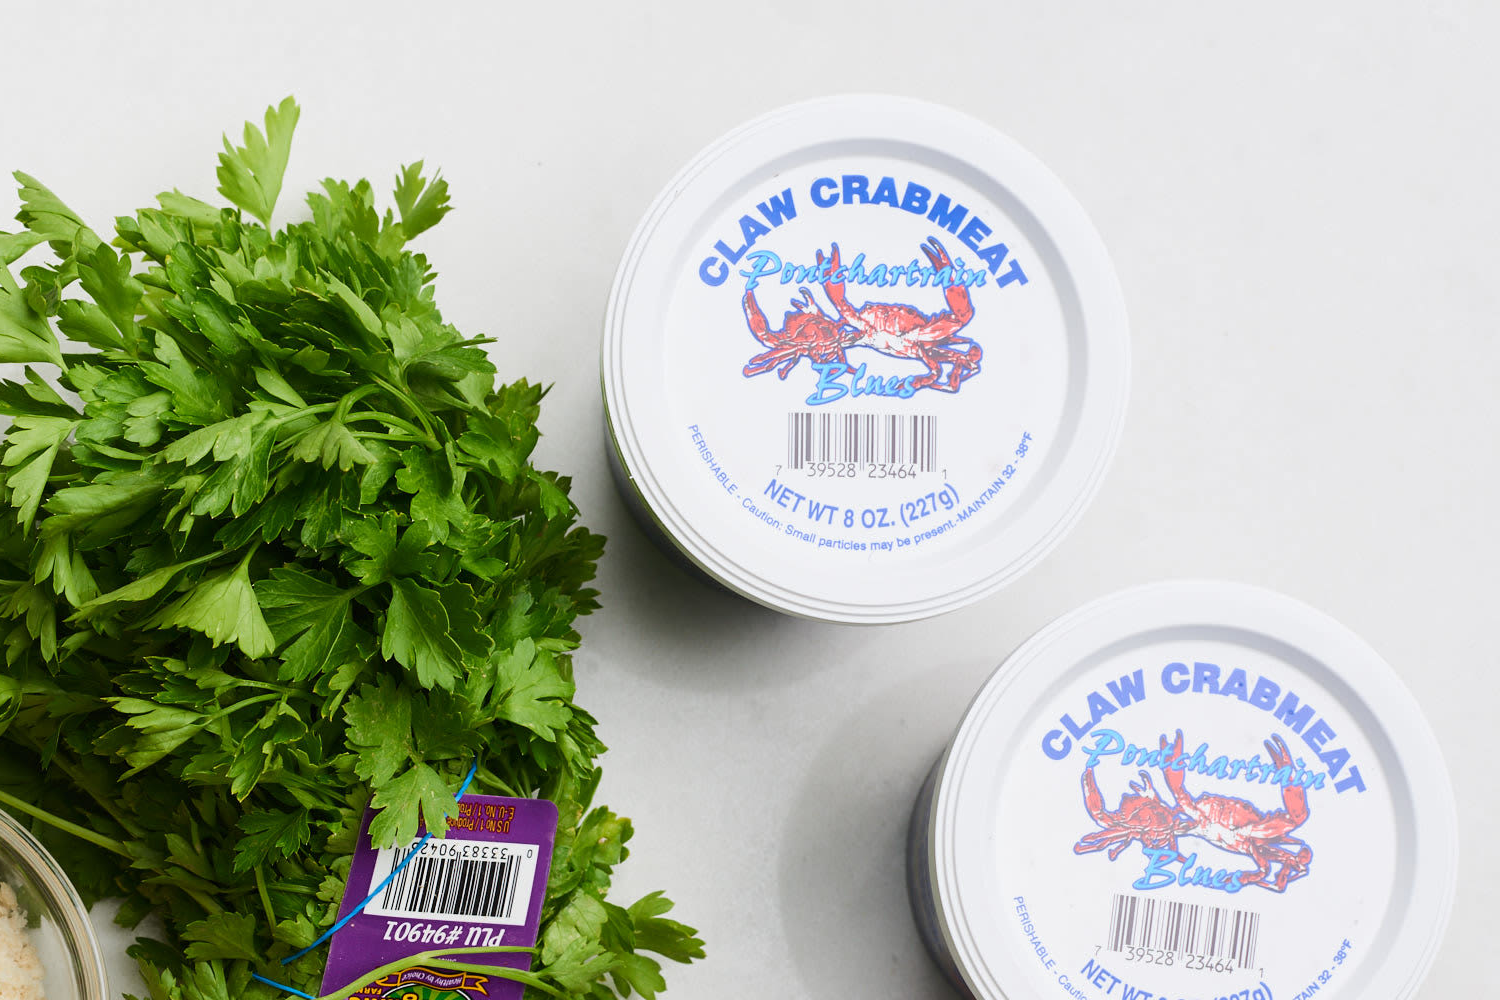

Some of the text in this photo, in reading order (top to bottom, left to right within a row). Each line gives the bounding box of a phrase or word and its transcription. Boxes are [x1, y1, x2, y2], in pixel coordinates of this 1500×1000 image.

[699, 174, 1029, 289] CLAW CRABMEAT
[740, 250, 987, 290] Pontchartrain
[805, 362, 918, 406] Blues
[688, 423, 738, 495] PERISHABLE
[741, 497, 783, 531] Caution:
[785, 524, 816, 543] Small
[818, 536, 867, 551] particles
[870, 540, 893, 551] may
[896, 538, 911, 548] be
[1002, 464, 1017, 479] 32
[807, 462, 856, 478] 39528
[868, 463, 917, 479] 23464
[764, 478, 960, 529] NET WT 8 OZ. (227g)
[1041, 662, 1367, 796] CLAW CRABMEAT
[1081, 728, 1327, 791] Pontchartrain
[462, 845, 509, 860] 33383
[526, 849, 533, 859] 0
[1132, 848, 1243, 893] Blues
[383, 921, 506, 947] PLU #94901
[1013, 895, 1056, 970] PERISHABLE
[1317, 969, 1333, 985] 32
[401, 971, 463, 987] Healthy by Choice
[1080, 958, 1122, 995] NET
[1125, 946, 1174, 966] 39528
[1185, 954, 1234, 974] 23464
